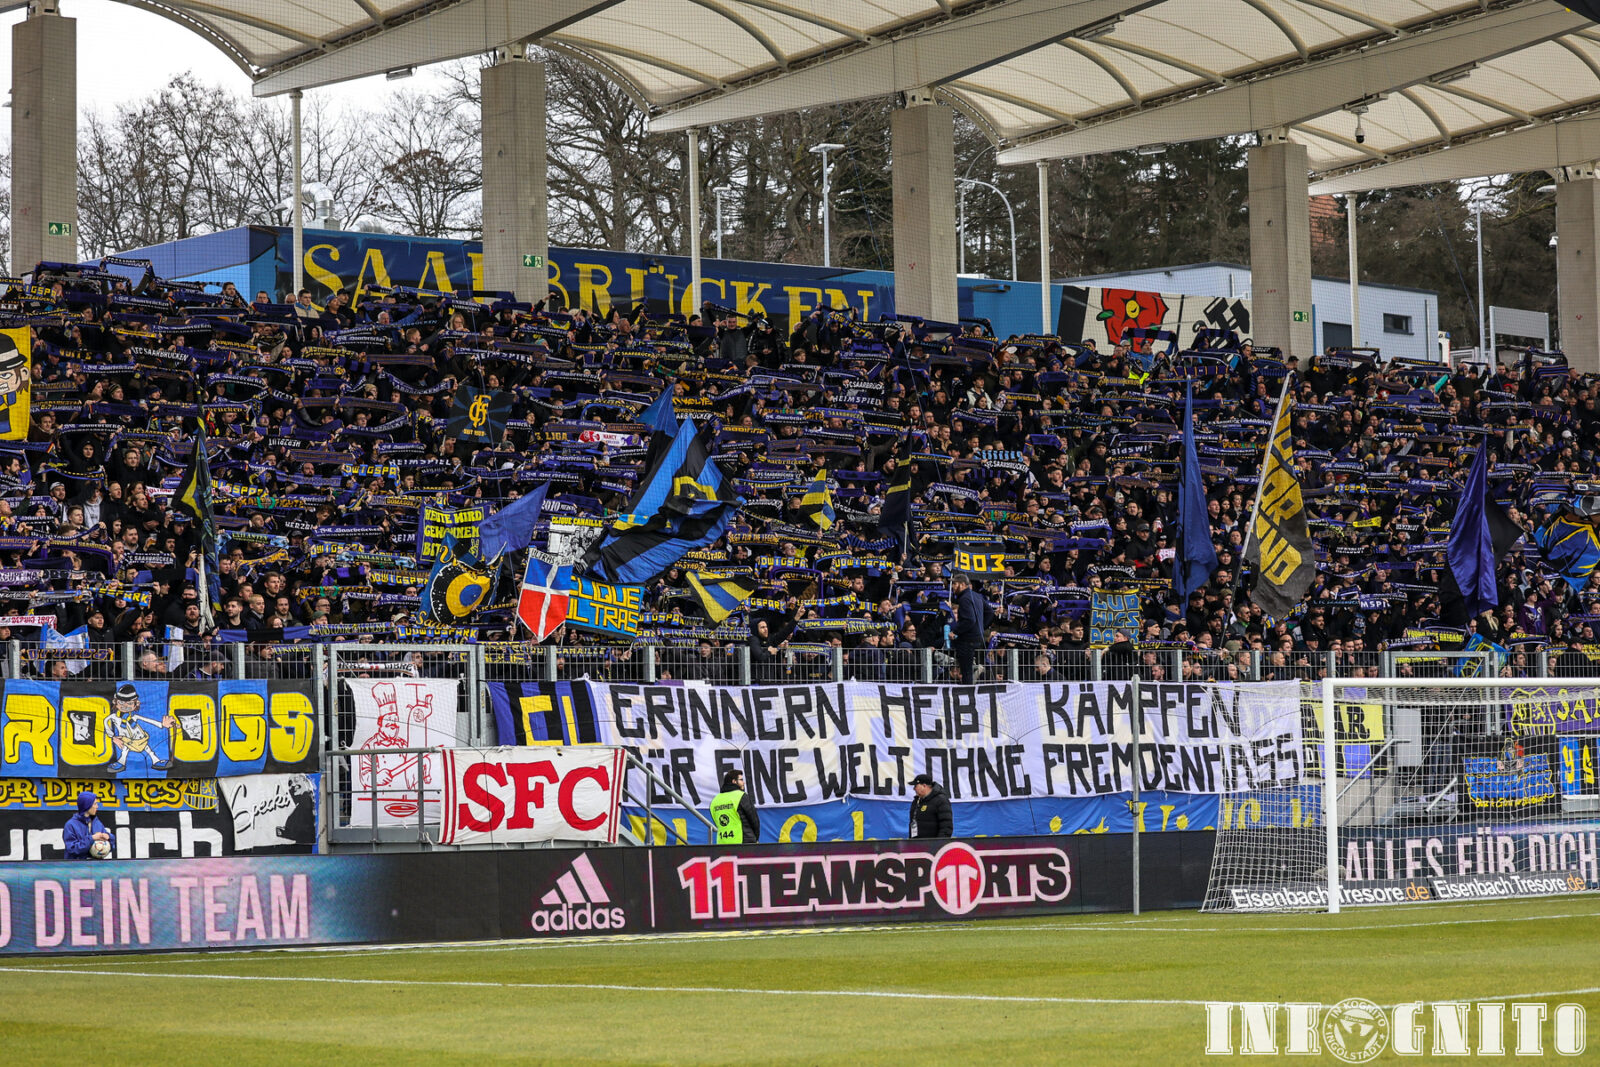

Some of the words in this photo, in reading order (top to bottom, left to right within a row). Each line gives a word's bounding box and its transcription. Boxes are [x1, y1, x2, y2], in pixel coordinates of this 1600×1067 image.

[545, 431, 569, 441] LIGA
[424, 508, 453, 524] HEUTE
[453, 509, 483, 524] WIRD
[573, 516, 604, 528] CANAILLE
[954, 550, 1005, 572] 1903
[568, 576, 641, 611] CLIQUE
[1091, 593, 1140, 611] LUD
[1091, 610, 1140, 629] WIGS
[1090, 628, 1139, 646] PAK
[609, 683, 851, 741] ERINNERN
[1043, 683, 1242, 738] KÄMPFEN
[715, 747, 808, 805] EINE
[814, 742, 910, 800] WELT
[925, 744, 1032, 799] OHNE
[1043, 732, 1300, 796] FREMDENHASS
[124, 779, 183, 804] FCS
[459, 760, 610, 832] SFC
[719, 830, 735, 840] 144
[1346, 837, 1443, 881] ALLES
[1458, 825, 1516, 877] FÜR
[1529, 830, 1600, 885] DICH
[34, 877, 150, 948] DEIN
[171, 873, 310, 944] TEAM
[531, 902, 626, 932] adidas
